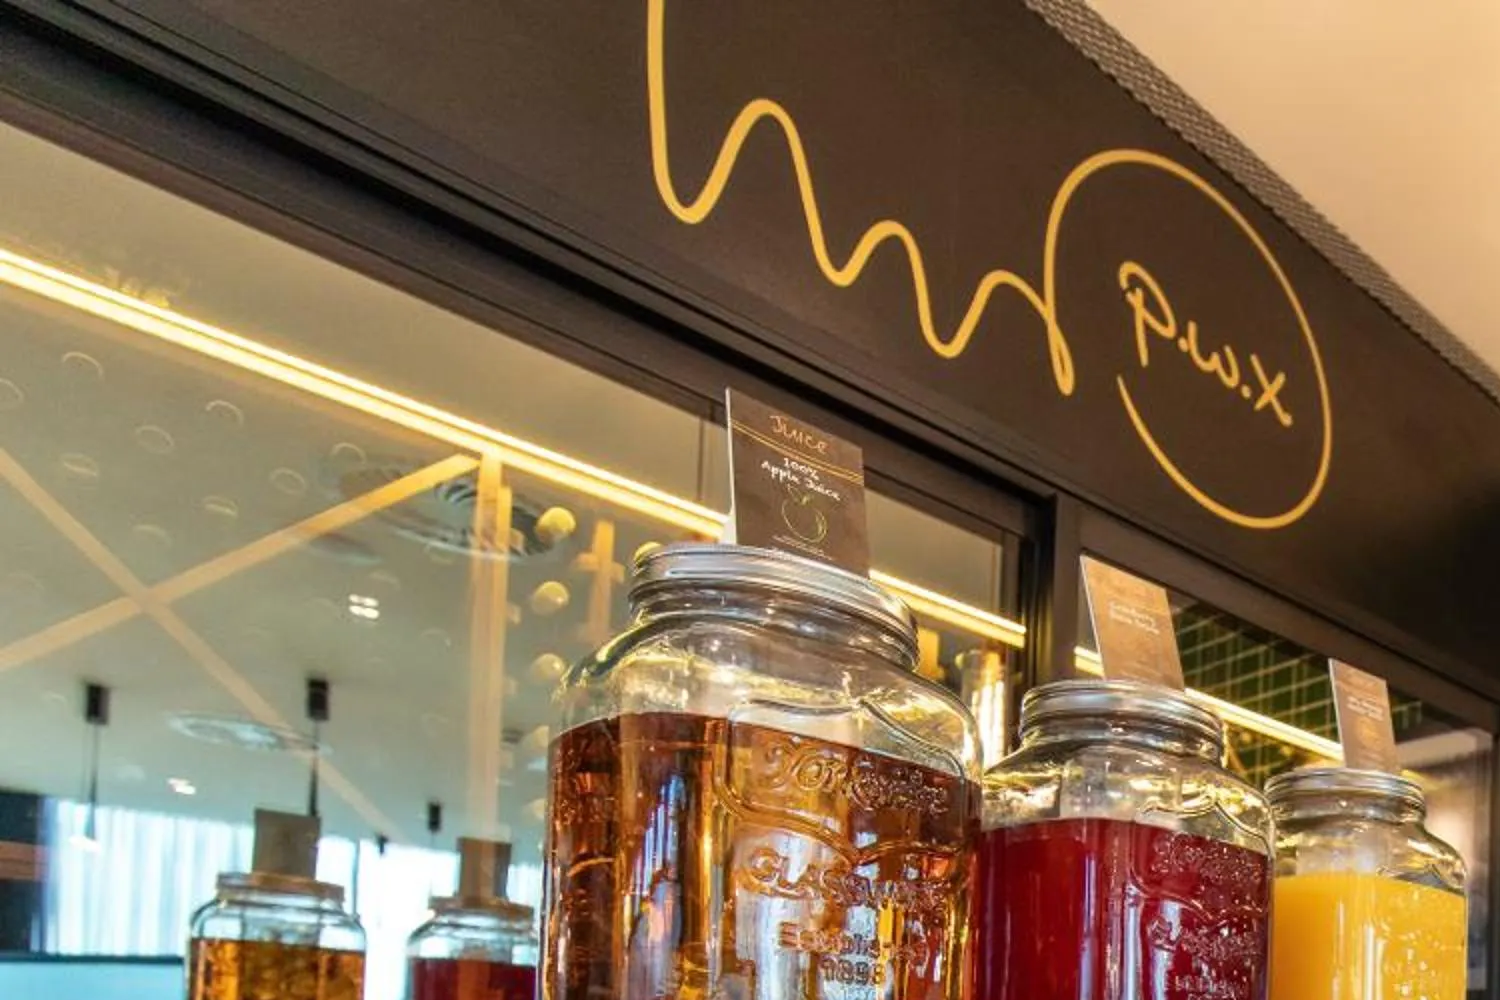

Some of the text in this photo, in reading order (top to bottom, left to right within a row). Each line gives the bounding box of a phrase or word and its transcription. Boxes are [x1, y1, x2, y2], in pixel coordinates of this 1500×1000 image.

[761, 460, 841, 501] Apple Juice
[783, 457, 820, 481] 100%
